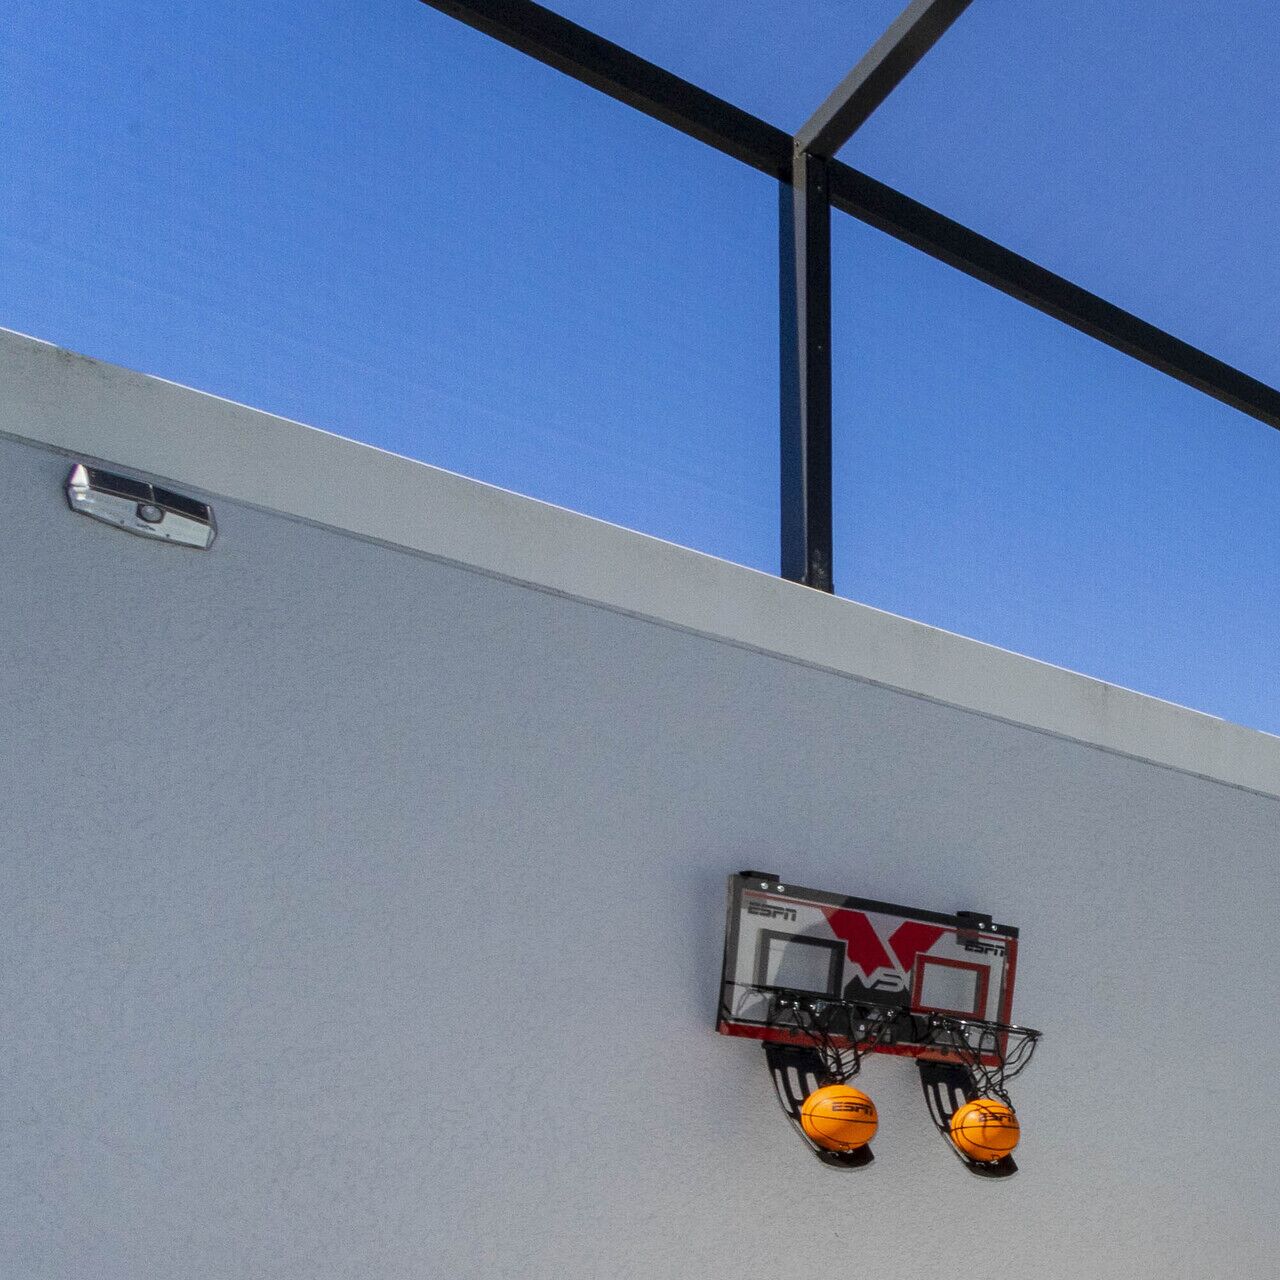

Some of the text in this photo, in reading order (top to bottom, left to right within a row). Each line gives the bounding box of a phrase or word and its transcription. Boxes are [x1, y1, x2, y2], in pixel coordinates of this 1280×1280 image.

[748, 901, 797, 922] ESPN
[965, 940, 1005, 957] ESPN
[832, 1101, 873, 1116] ESPN
